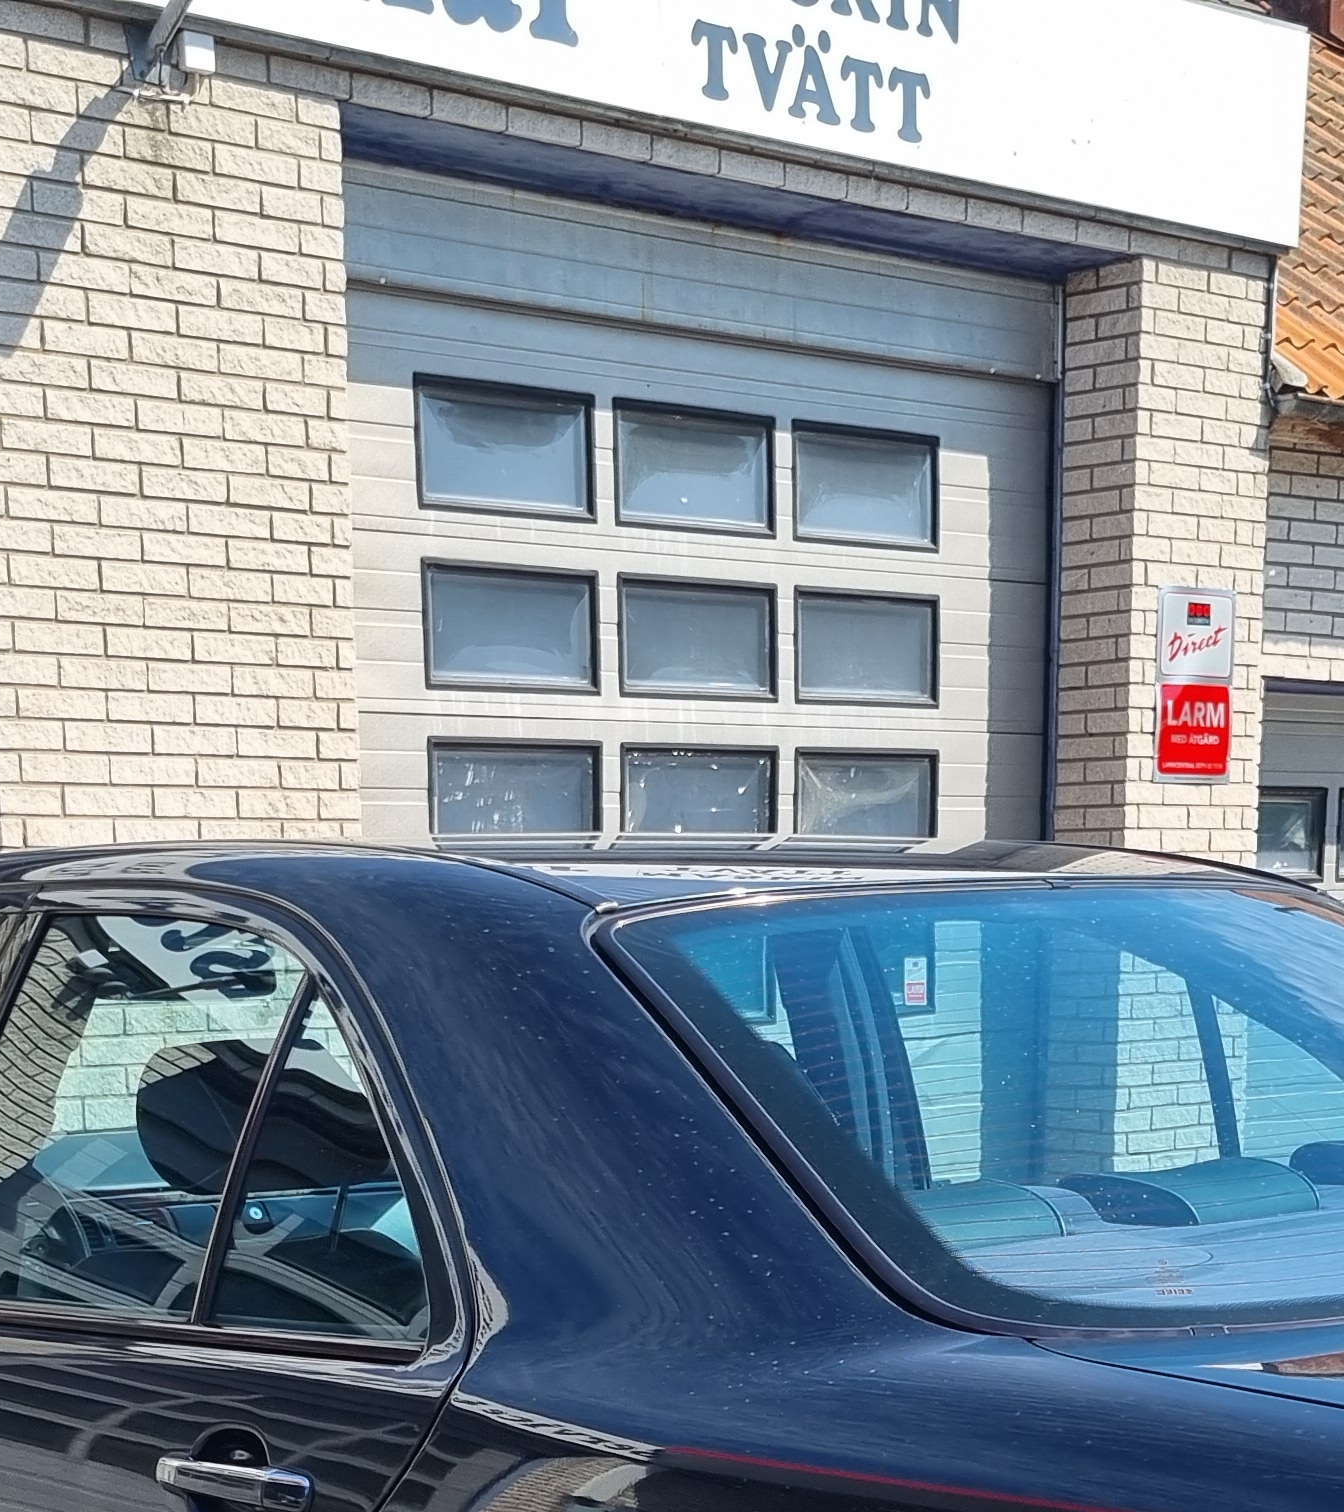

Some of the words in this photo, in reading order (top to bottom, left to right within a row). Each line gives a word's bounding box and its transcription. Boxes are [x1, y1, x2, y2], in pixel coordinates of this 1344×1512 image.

[691, 19, 931, 144] TVÄTT
[1167, 626, 1228, 663] Direct
[1167, 700, 1225, 729] LARM
